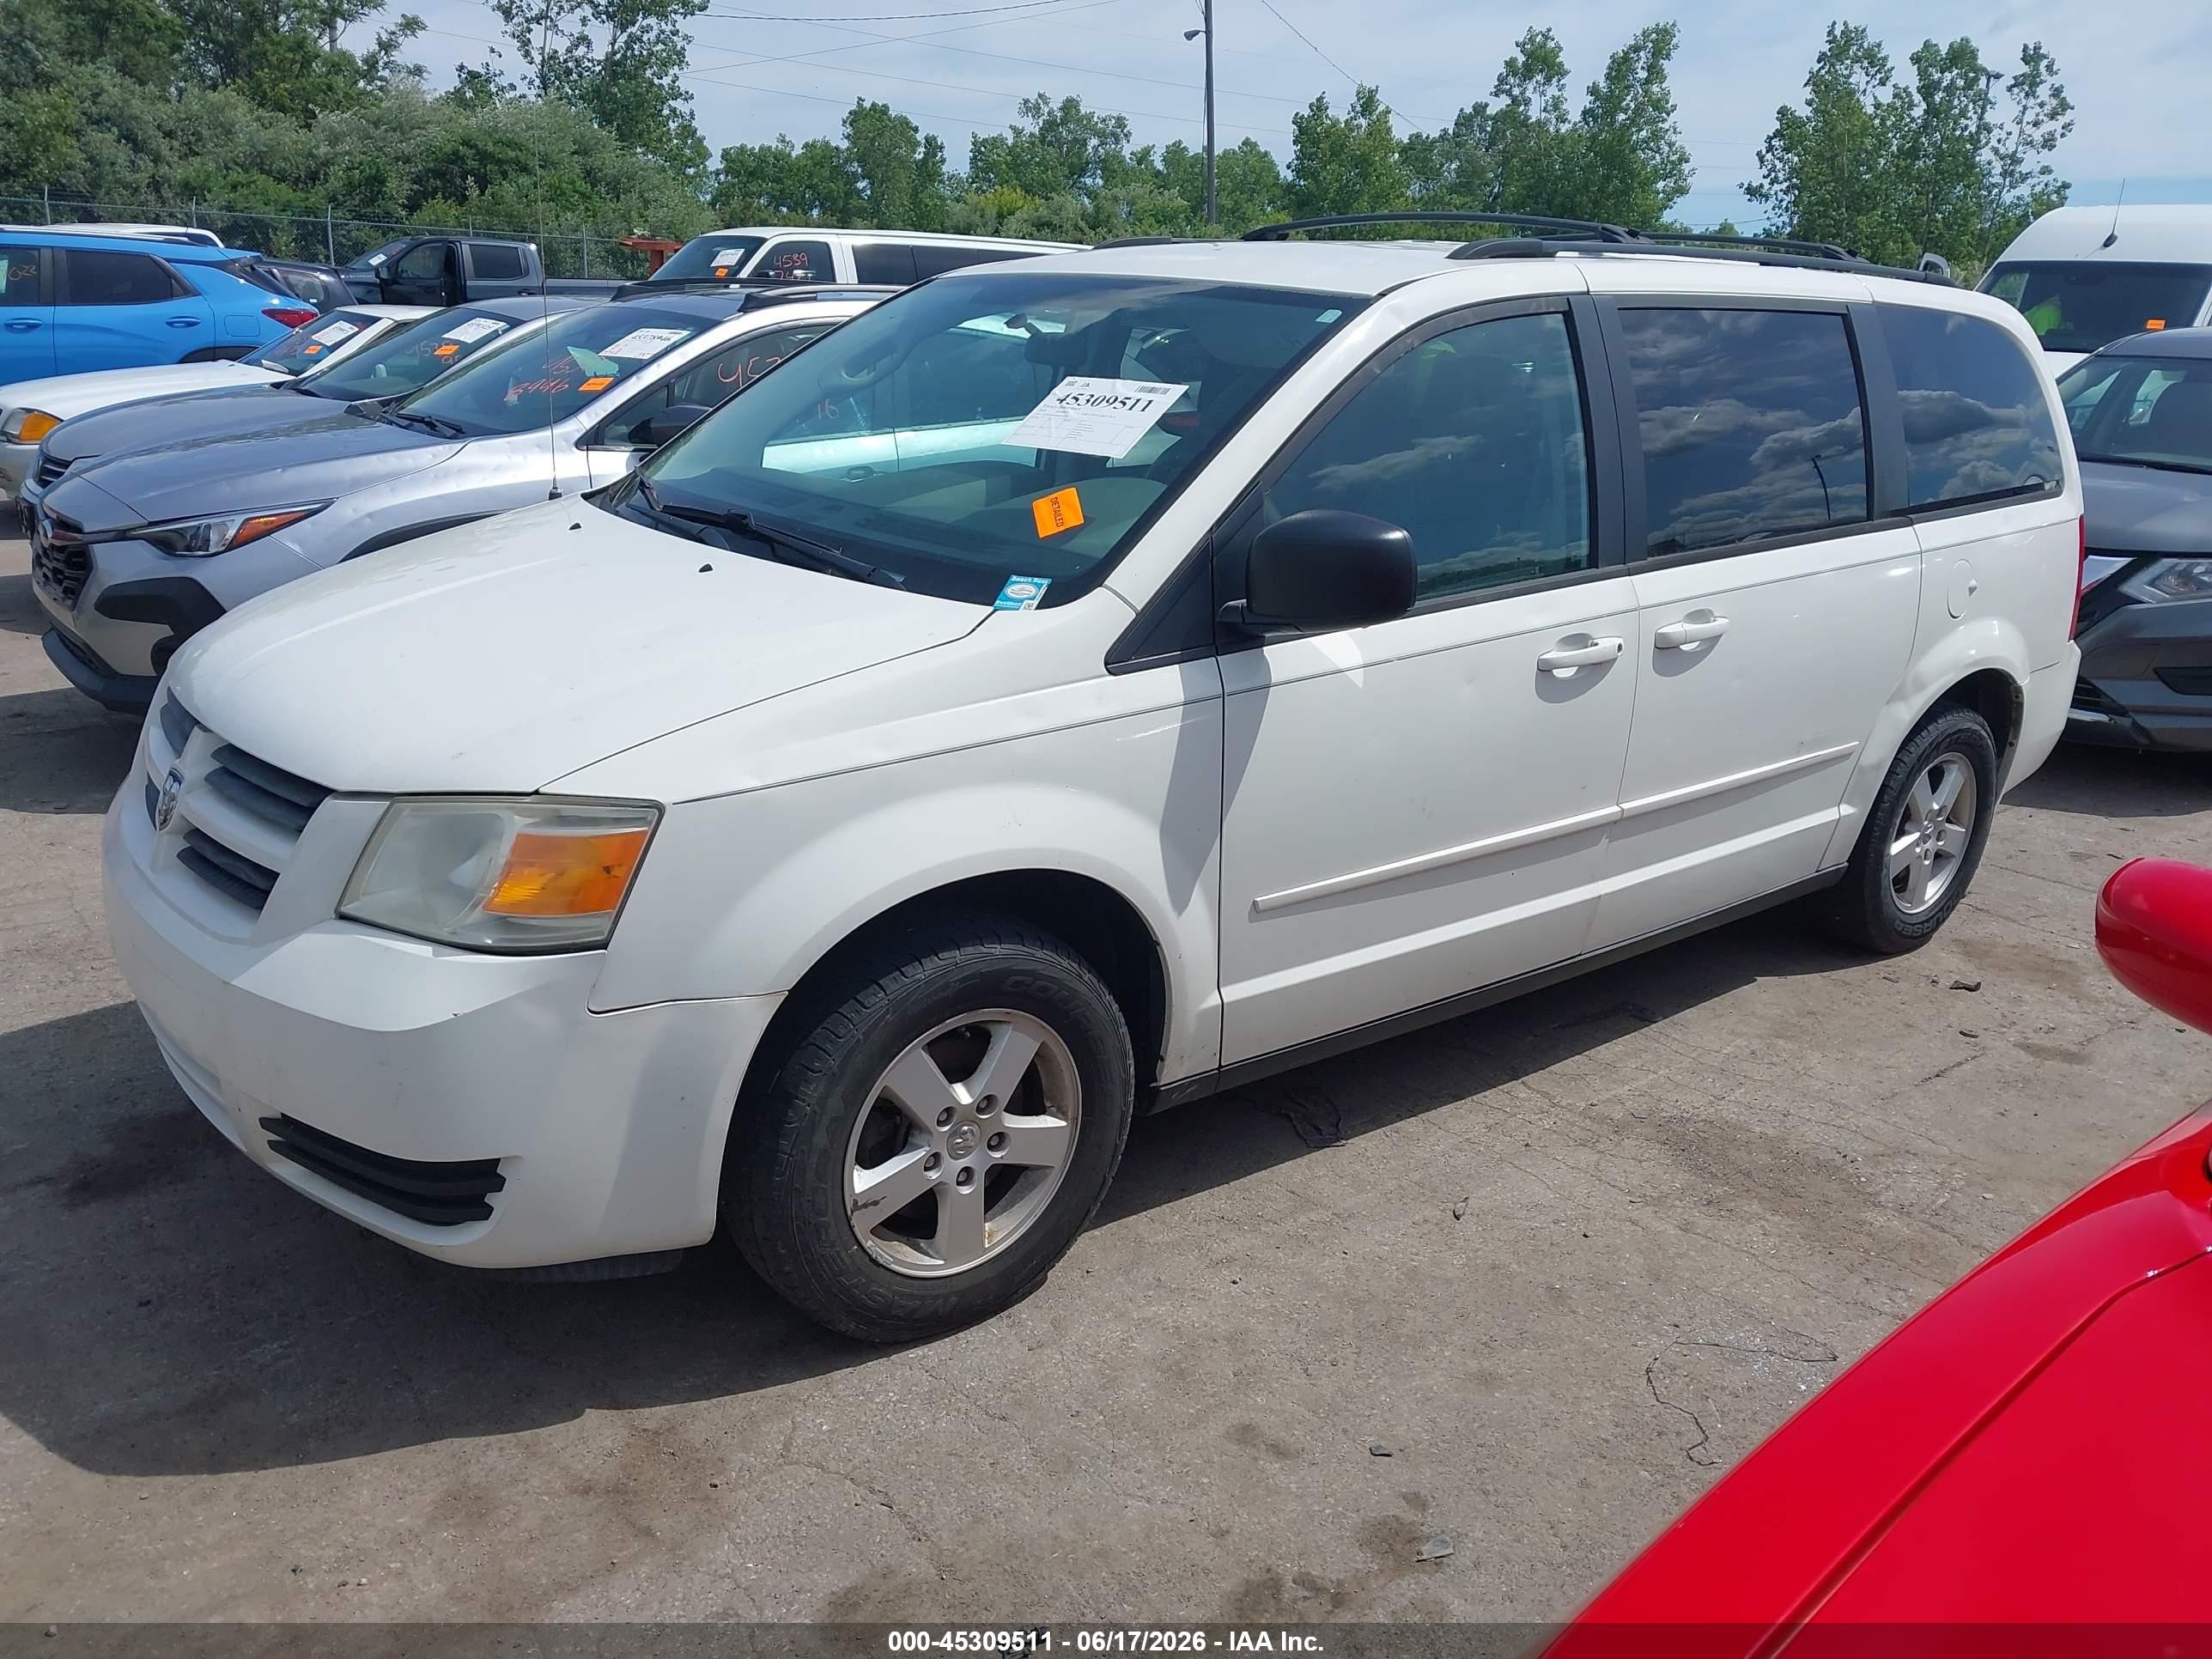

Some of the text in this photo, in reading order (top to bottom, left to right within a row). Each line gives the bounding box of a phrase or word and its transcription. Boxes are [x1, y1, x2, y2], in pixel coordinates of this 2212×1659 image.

[774, 252, 809, 269] 4539
[1056, 392, 1154, 412] 45309511
[1050, 496, 1064, 527] DETAILED
